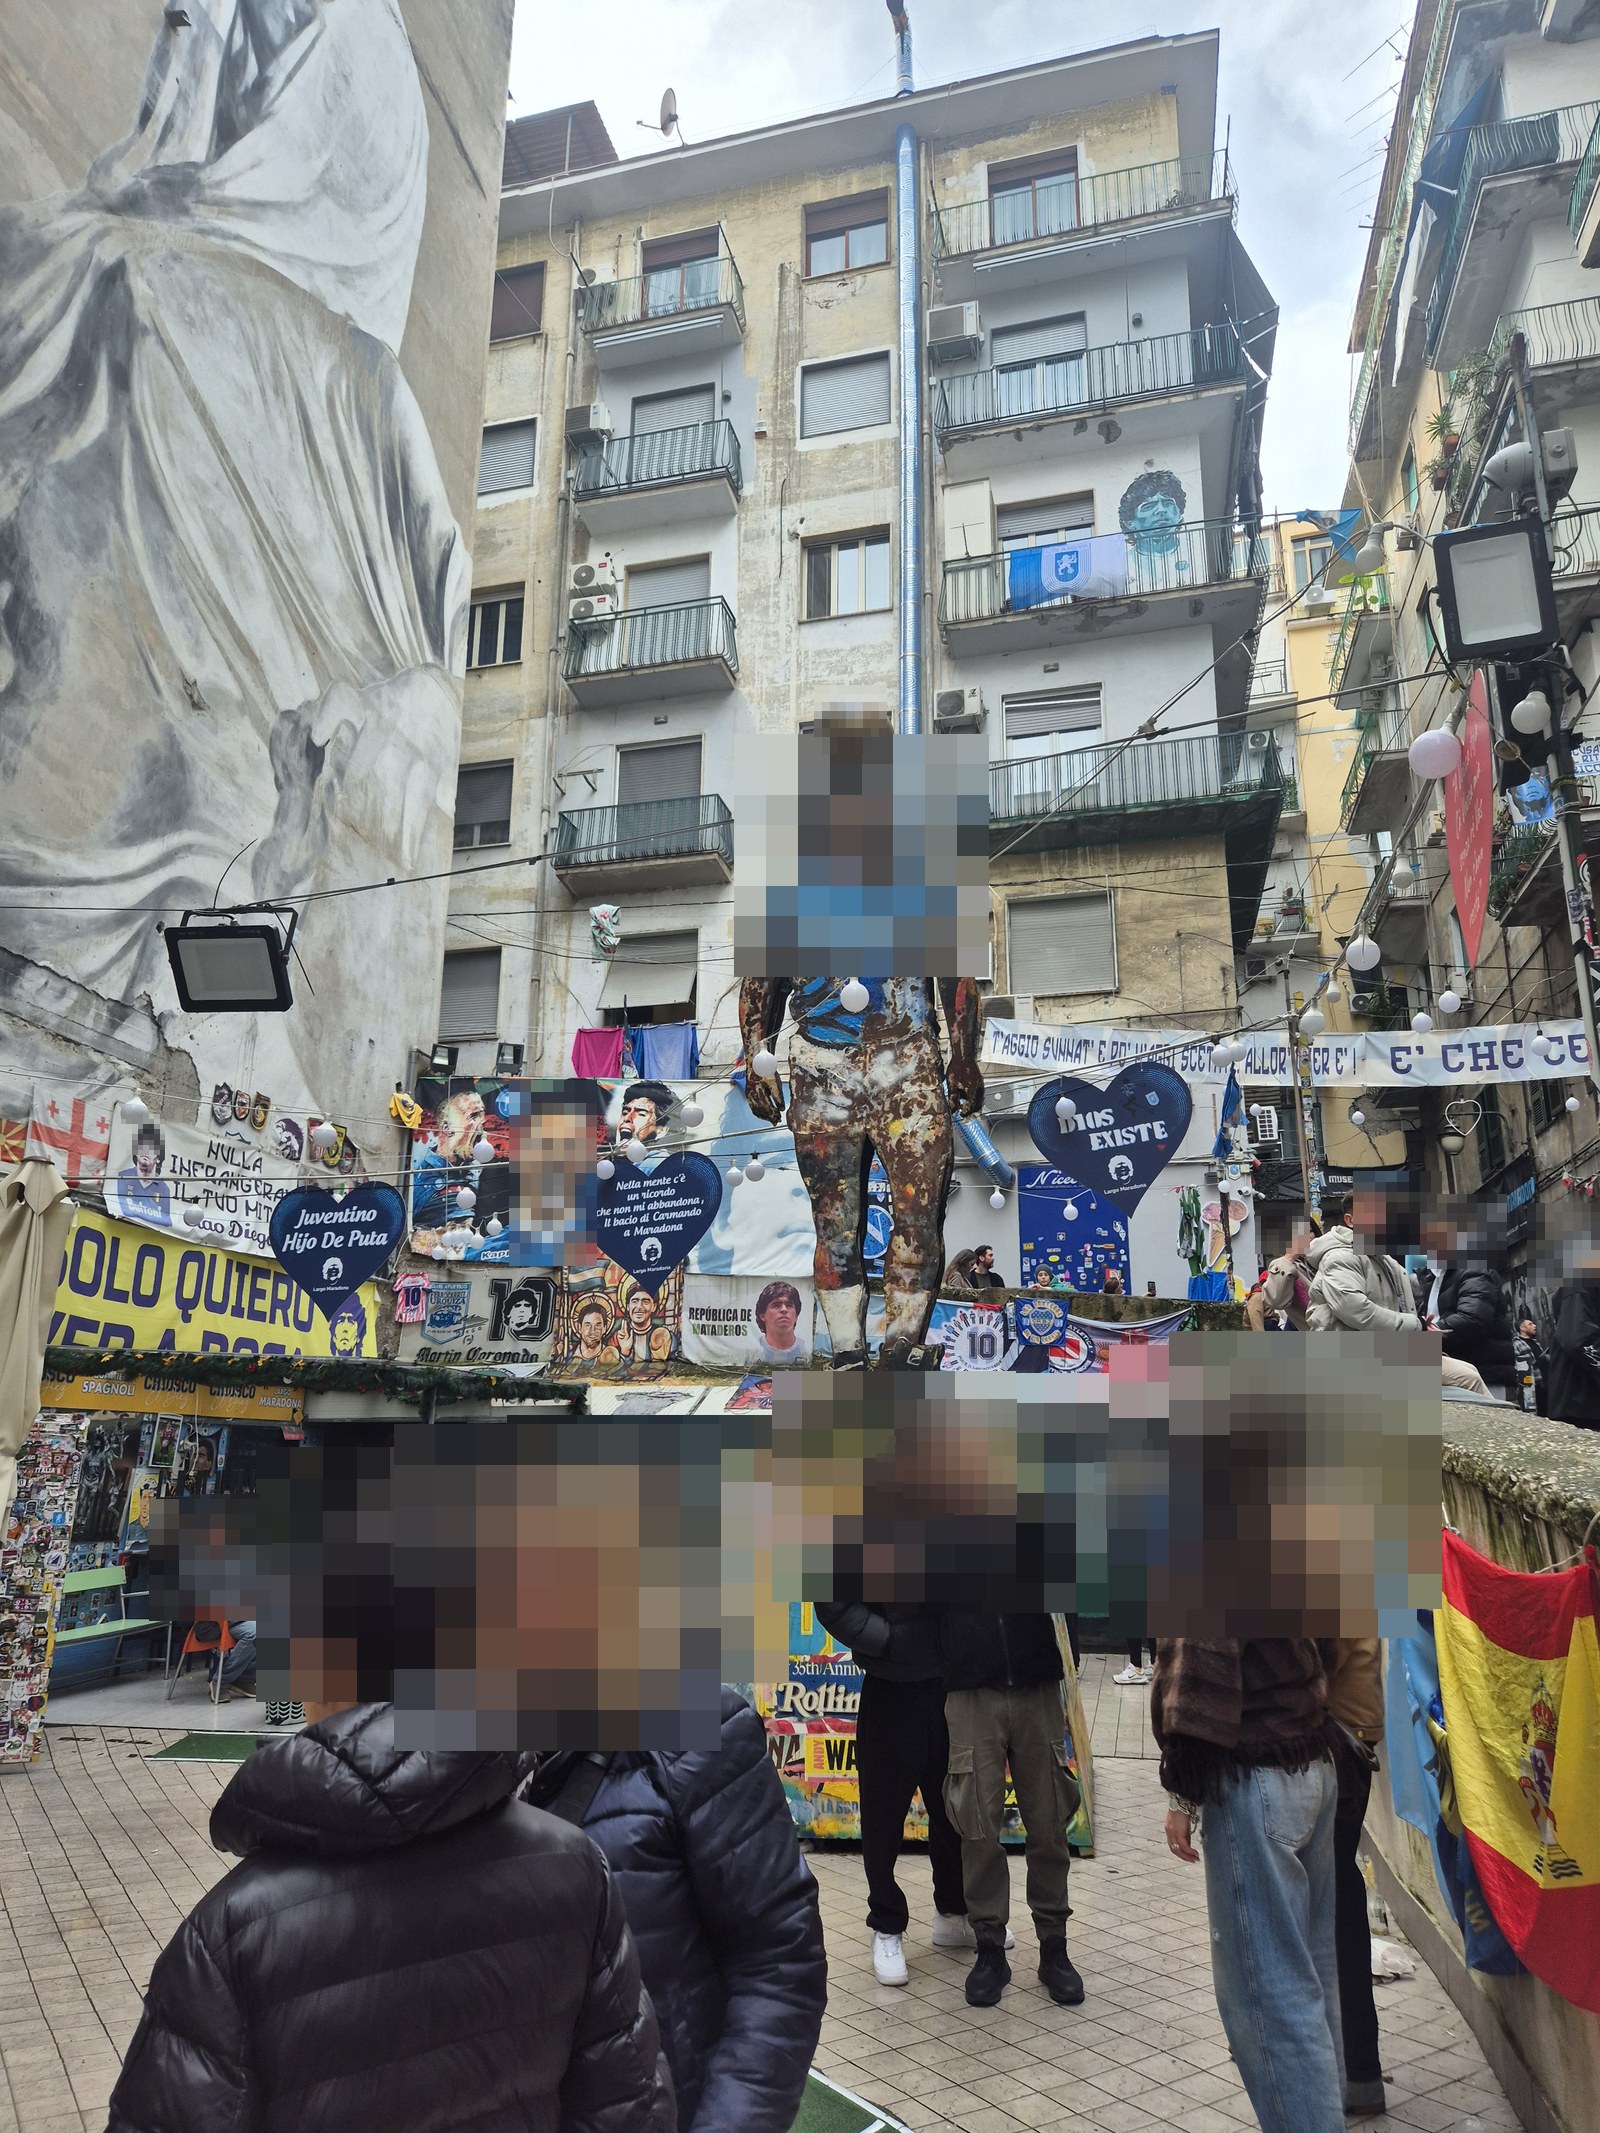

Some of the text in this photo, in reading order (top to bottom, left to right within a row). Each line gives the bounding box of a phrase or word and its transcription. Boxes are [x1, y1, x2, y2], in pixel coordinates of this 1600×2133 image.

[1441, 1039, 1525, 1073] CHE
[1057, 1109, 1115, 1134] DIOS
[1088, 1120, 1169, 1151] EXISTE
[616, 1179, 641, 1191] Nella
[643, 1176, 671, 1187] mente
[1328, 1175, 1353, 1184] MUSE
[627, 1187, 675, 1201] un ricordo
[1103, 1183, 1147, 1195] Largo Maradona
[245, 1199, 273, 1223] MIT
[613, 1207, 631, 1215] non
[633, 1202, 645, 1212] mi
[293, 1206, 378, 1229] Juventino
[613, 1216, 638, 1227] bacio
[640, 1213, 649, 1223] di
[653, 1208, 702, 1222] Carmando
[633, 1223, 683, 1236] Maradona
[282, 1230, 389, 1254] Hijo De Puta
[689, 1305, 752, 1322] REPÚBLICA DE
[692, 1323, 748, 1337] MATADEROS
[967, 1331, 998, 1360] 10
[82, 1380, 136, 1397] SPAGNOLI
[259, 1396, 302, 1409] MARADONA
[823, 1662, 866, 1676] Anniv
[777, 1681, 861, 1718] Rollin
[813, 1739, 859, 1771] ANDY WA
